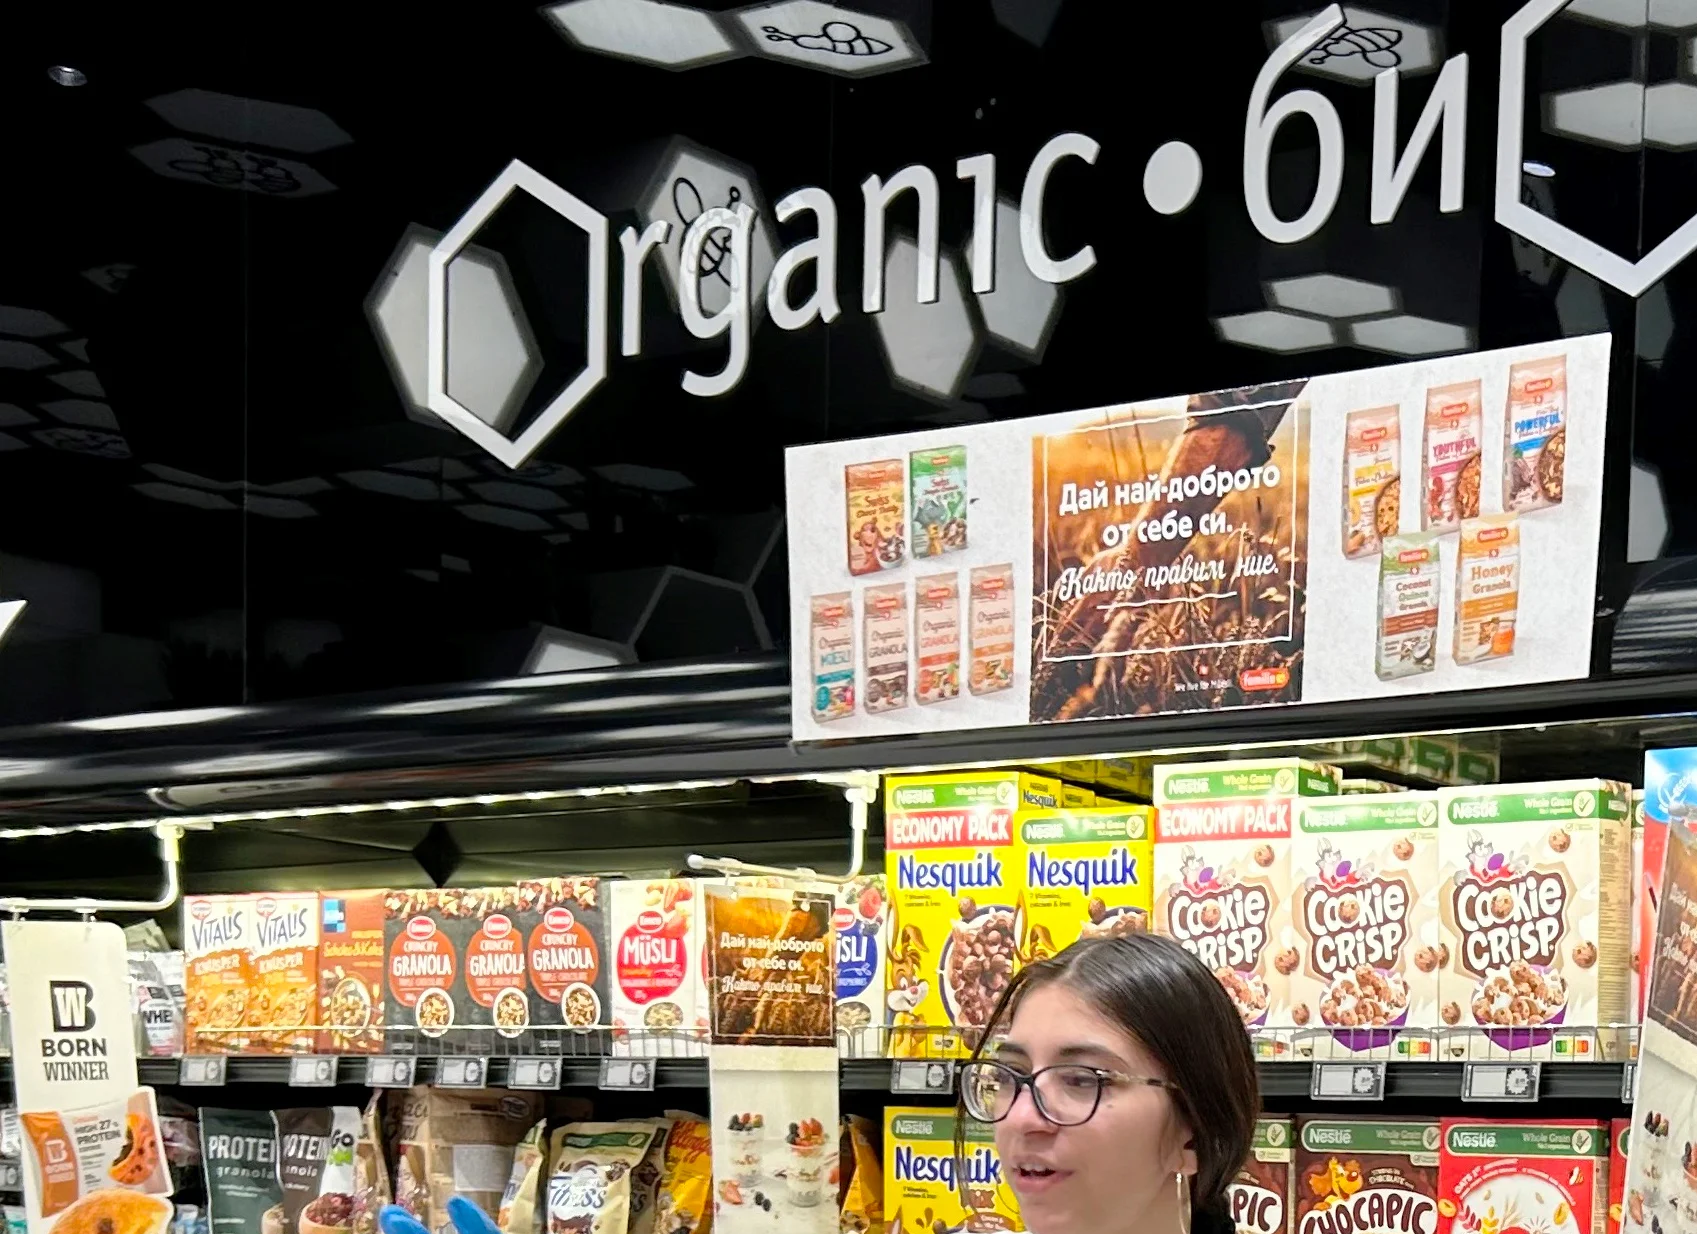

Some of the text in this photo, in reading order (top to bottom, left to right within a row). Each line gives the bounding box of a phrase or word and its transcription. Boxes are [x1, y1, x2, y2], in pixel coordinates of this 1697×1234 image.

[1059, 465, 1281, 516] Дай най-доброто
[1103, 510, 1233, 547] от себе си.
[1059, 553, 1279, 601] Както правим ние.
[892, 812, 1009, 844] ECONOMY PACK
[1160, 804, 1288, 837] ECONOMY PACK
[899, 852, 1003, 897] Nesquik
[1028, 848, 1139, 897] Nesquik
[192, 911, 243, 949] VITALIS
[256, 907, 307, 948] VITALIS
[720, 931, 745, 949] Дай
[393, 954, 452, 977] GRANOLA
[470, 954, 525, 976] GRANOLA
[533, 947, 594, 971] GRANOLA
[623, 936, 677, 966] MÜSLI
[757, 954, 784, 971] себе
[42, 1038, 107, 1058] BORN
[43, 1061, 109, 1082] WINNER
[208, 1135, 275, 1163] PROTEI
[1309, 1126, 1353, 1144] Nestlé
[1452, 1132, 1571, 1149] Nestlé Whole Grain
[895, 1146, 1002, 1192] Nesquik
